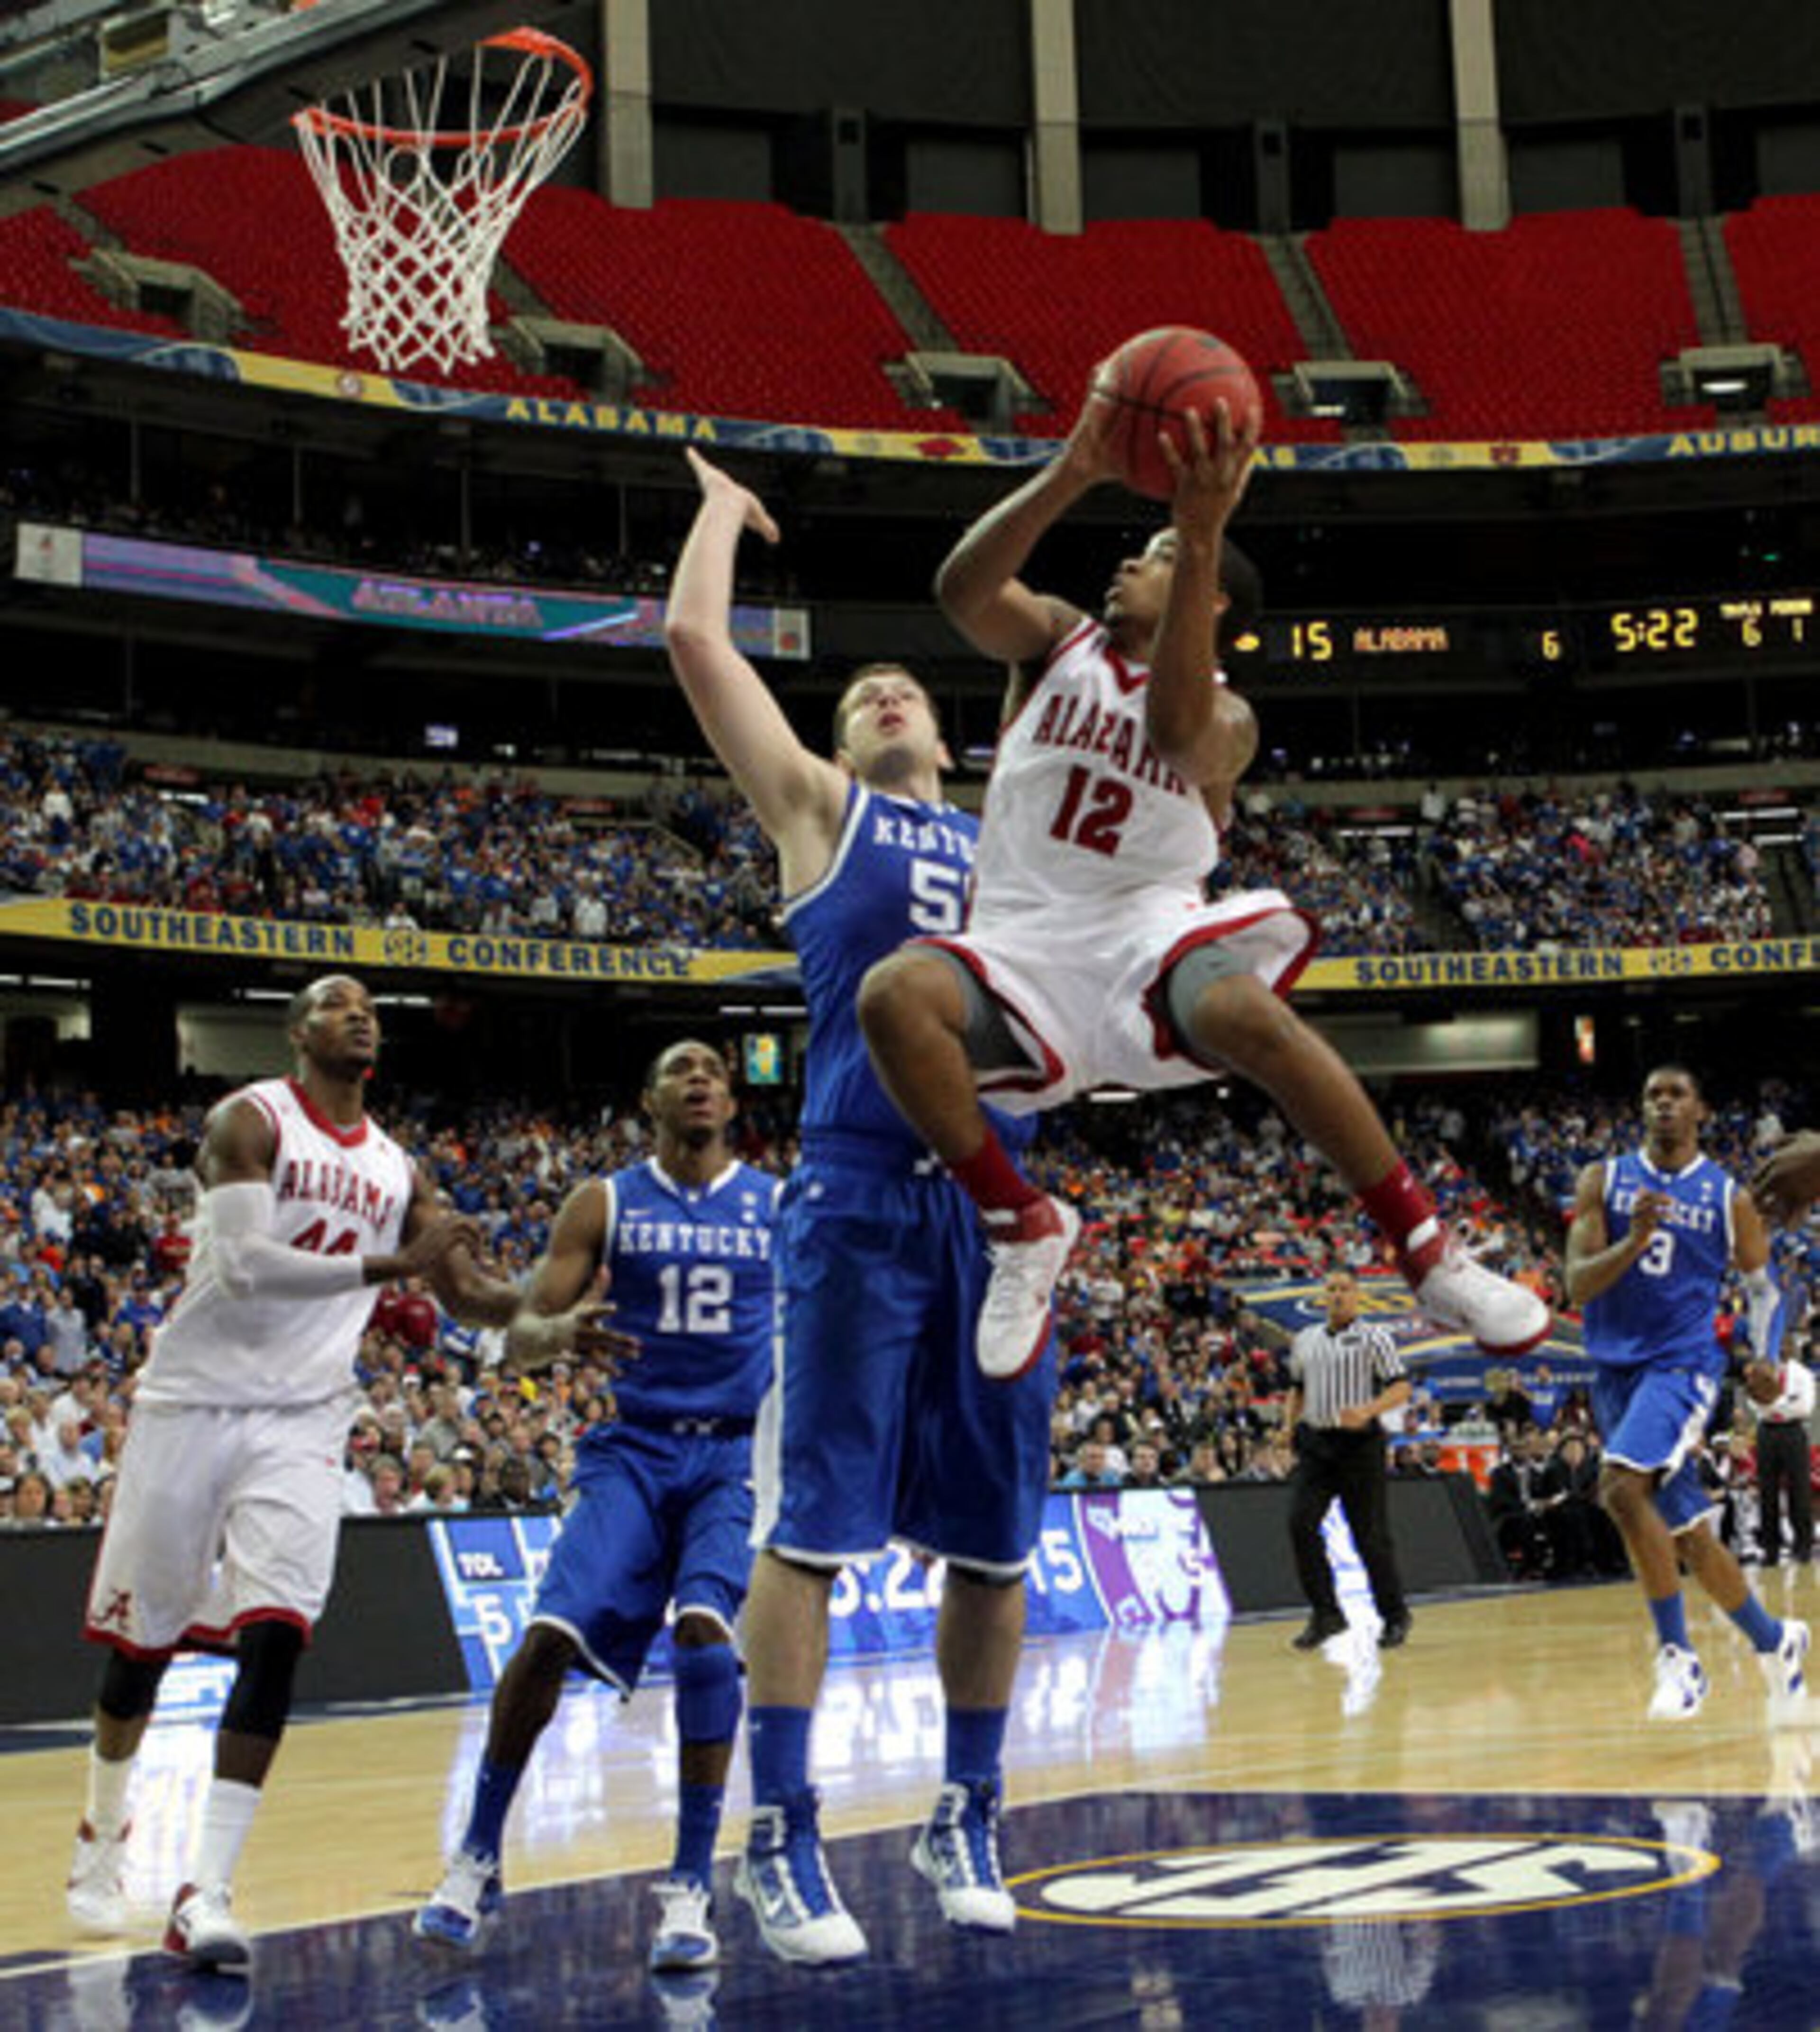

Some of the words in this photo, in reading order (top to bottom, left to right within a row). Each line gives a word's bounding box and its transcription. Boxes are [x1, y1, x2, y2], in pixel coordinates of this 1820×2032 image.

[506, 397, 717, 441] ALABAMA
[1292, 622, 1332, 660] 15
[1542, 631, 1560, 660] 6
[1611, 609, 1698, 651] 5:22
[1049, 763, 1134, 860] 12
[70, 901, 355, 956] SOUTHEASTERN
[448, 937, 690, 977] CONFERENCE
[1356, 950, 1623, 985] SOUTHEASTERN
[619, 1221, 772, 1261] KENTUCKY
[1638, 1230, 1674, 1277] 3
[656, 1263, 734, 1334] 12
[456, 1551, 504, 1577] TOL
